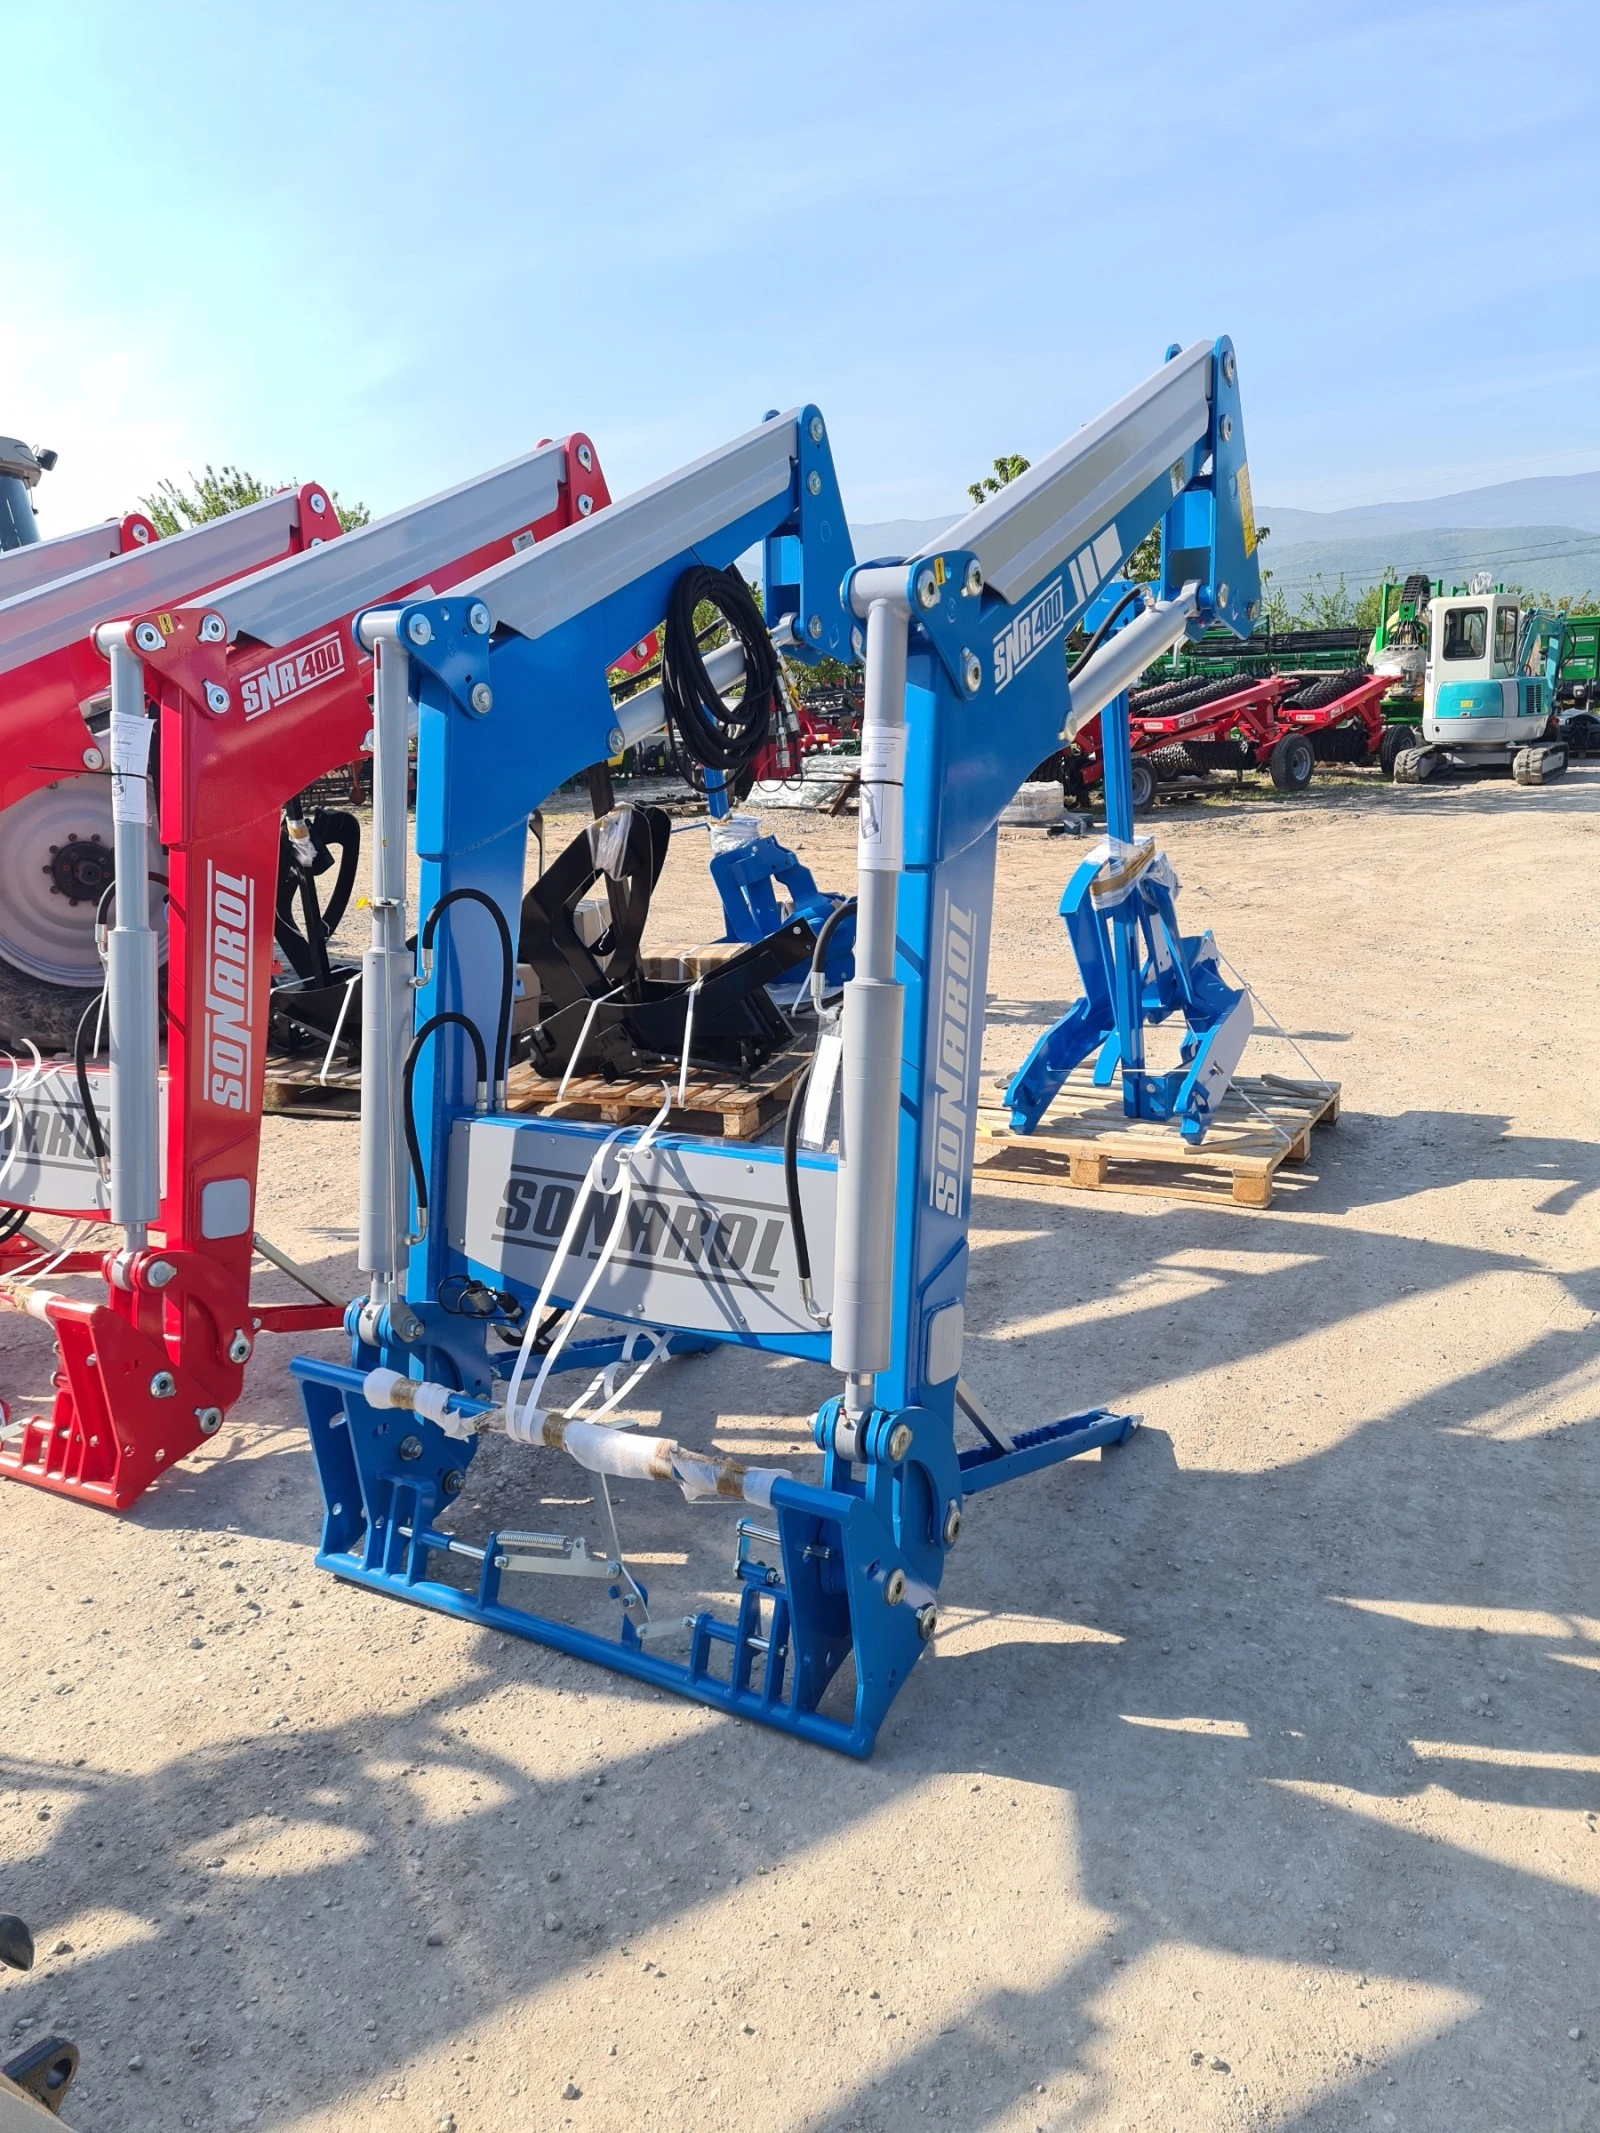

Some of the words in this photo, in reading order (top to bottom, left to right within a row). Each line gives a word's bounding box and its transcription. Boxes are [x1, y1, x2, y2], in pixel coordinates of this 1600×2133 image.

[206, 869, 252, 1110] SONAROL
[934, 902, 973, 1216] SONAROL
[495, 1177, 785, 1278] SONAROL
